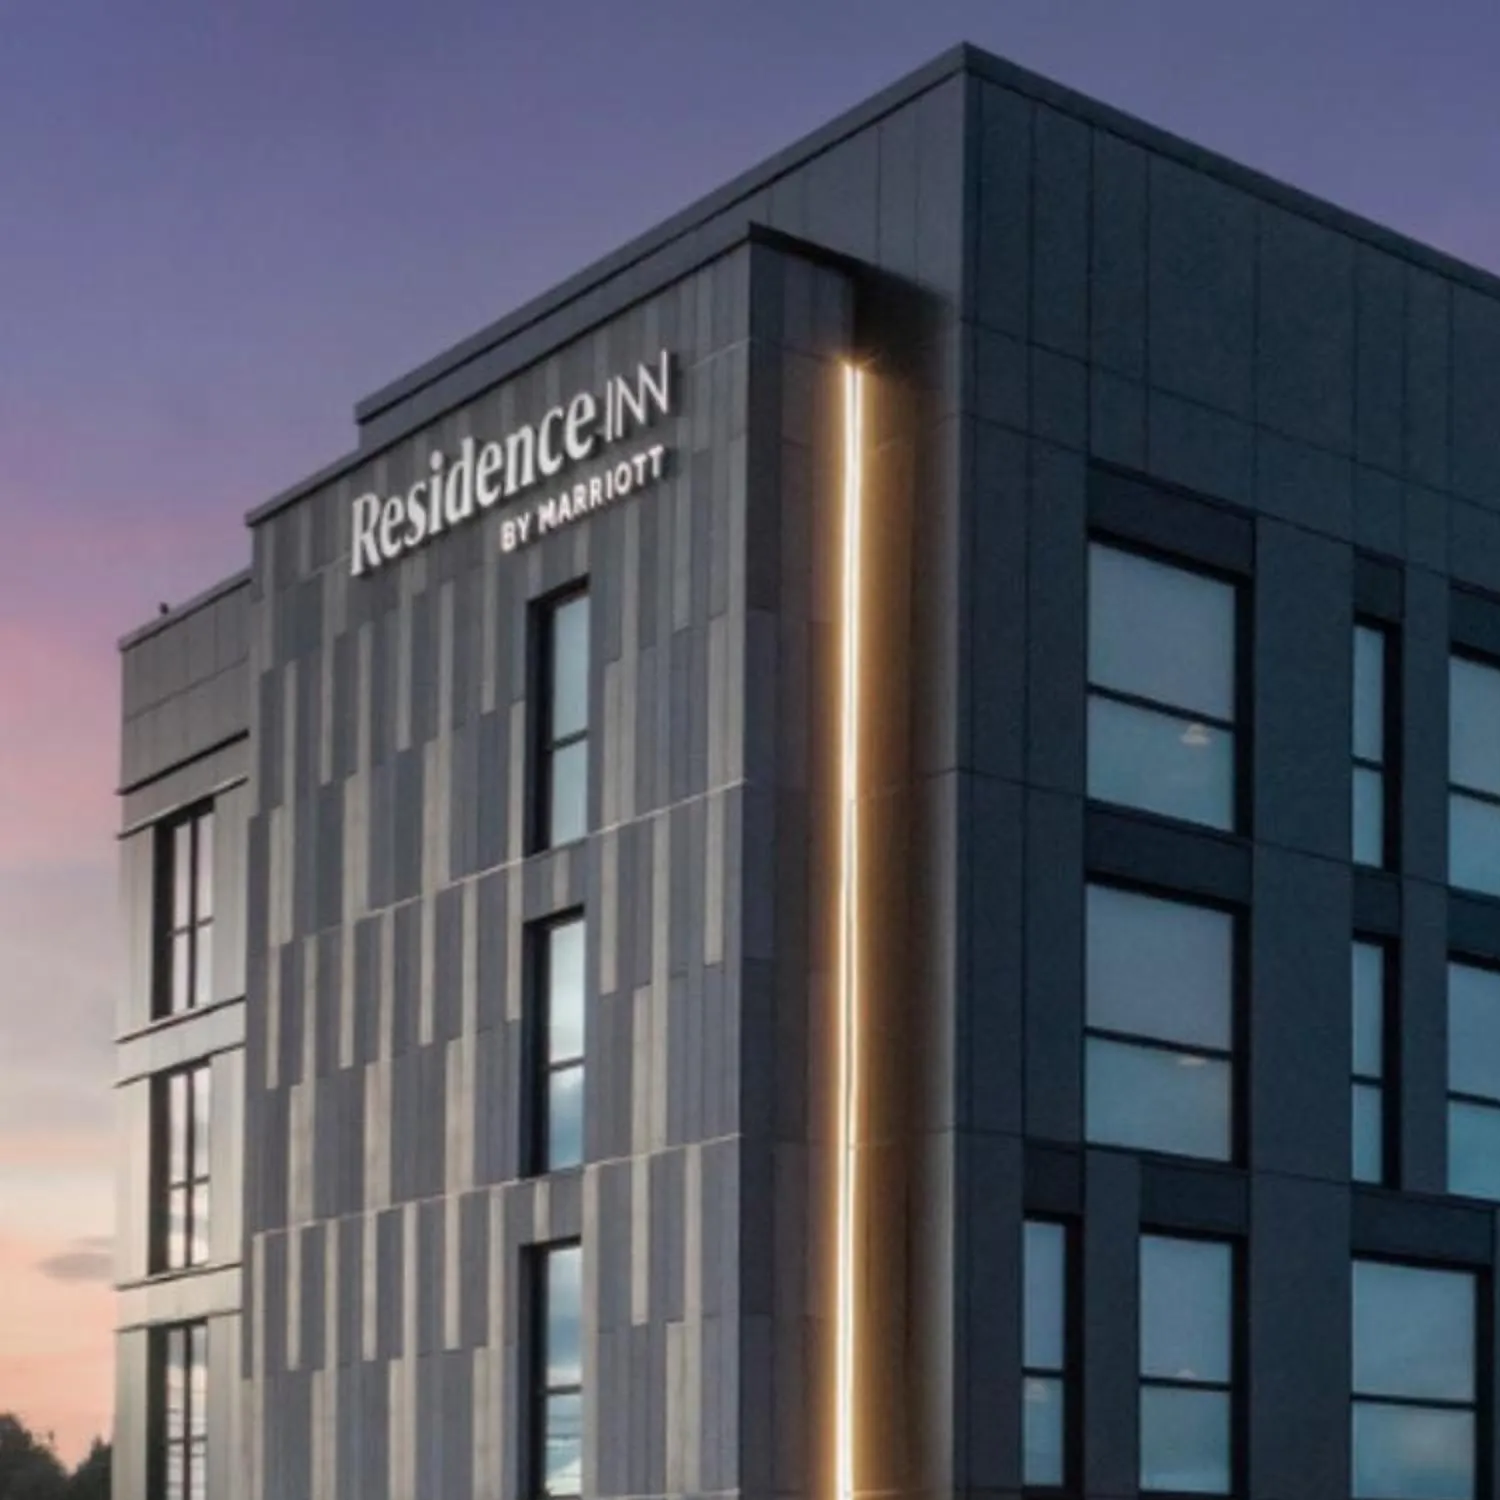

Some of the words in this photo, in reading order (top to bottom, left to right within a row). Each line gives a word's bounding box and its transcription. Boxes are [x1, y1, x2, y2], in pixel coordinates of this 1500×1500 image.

[351, 393, 597, 576] Residence
[605, 349, 669, 443] INN
[502, 512, 532, 552] BY
[538, 444, 665, 533] MARRIOTT
